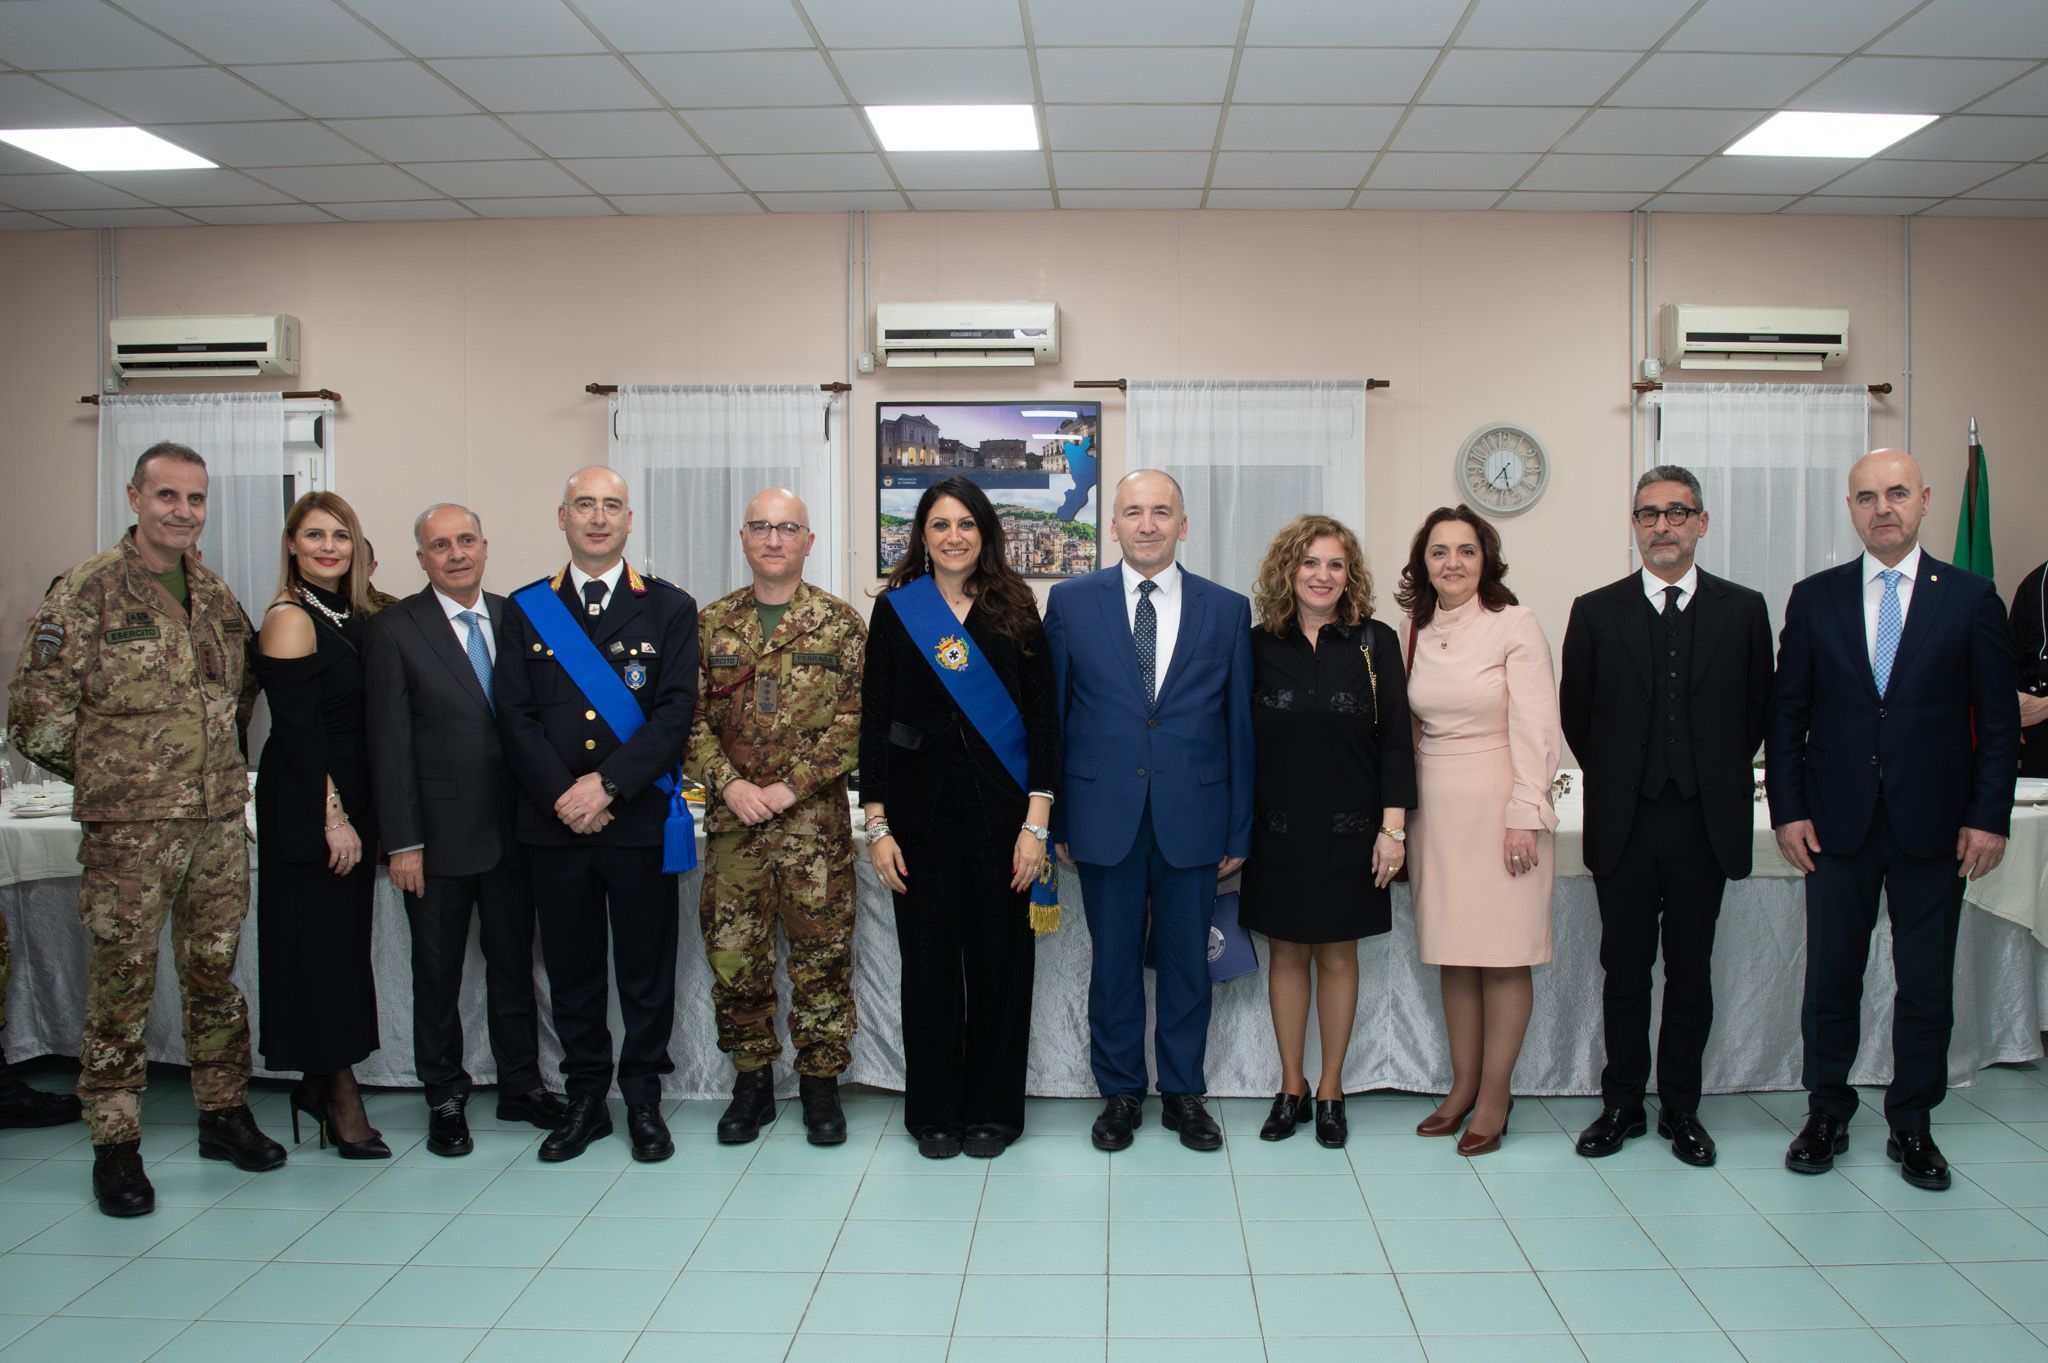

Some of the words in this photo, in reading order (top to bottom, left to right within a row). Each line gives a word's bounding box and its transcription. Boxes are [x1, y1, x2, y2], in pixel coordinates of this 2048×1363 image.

[1495, 432, 1511, 449] 12
[1469, 447, 1487, 463] 10
[1466, 464, 1483, 474] 9
[1471, 478, 1486, 492] 8
[112, 628, 155, 640] ESERCITO
[797, 654, 832, 664] FERRARA
